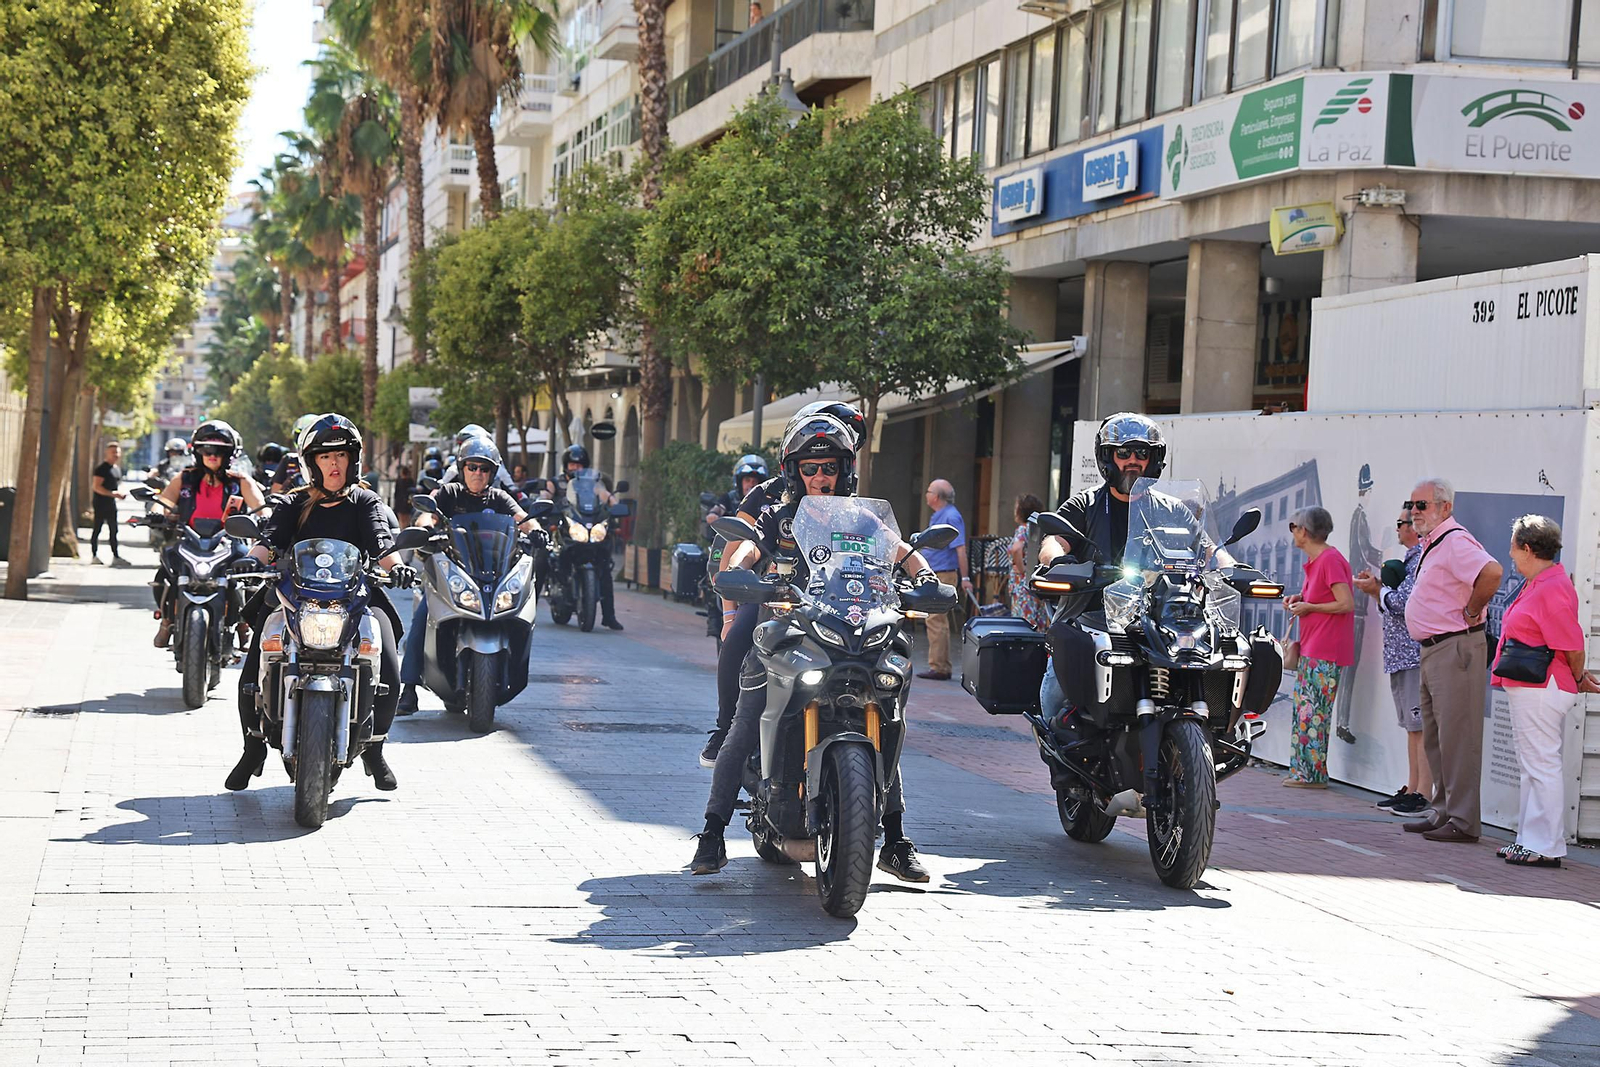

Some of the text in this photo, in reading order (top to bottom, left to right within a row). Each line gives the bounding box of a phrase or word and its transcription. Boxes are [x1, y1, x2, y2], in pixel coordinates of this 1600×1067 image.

[1263, 94, 1297, 112] Seguros para
[1270, 113, 1296, 129] Empresas
[1262, 132, 1294, 148] Instituciones
[1465, 134, 1572, 161] El Puente
[1307, 142, 1372, 163] La Paz
[1472, 286, 1579, 323] 392 EL PICOTE
[840, 541, 870, 554] 003
